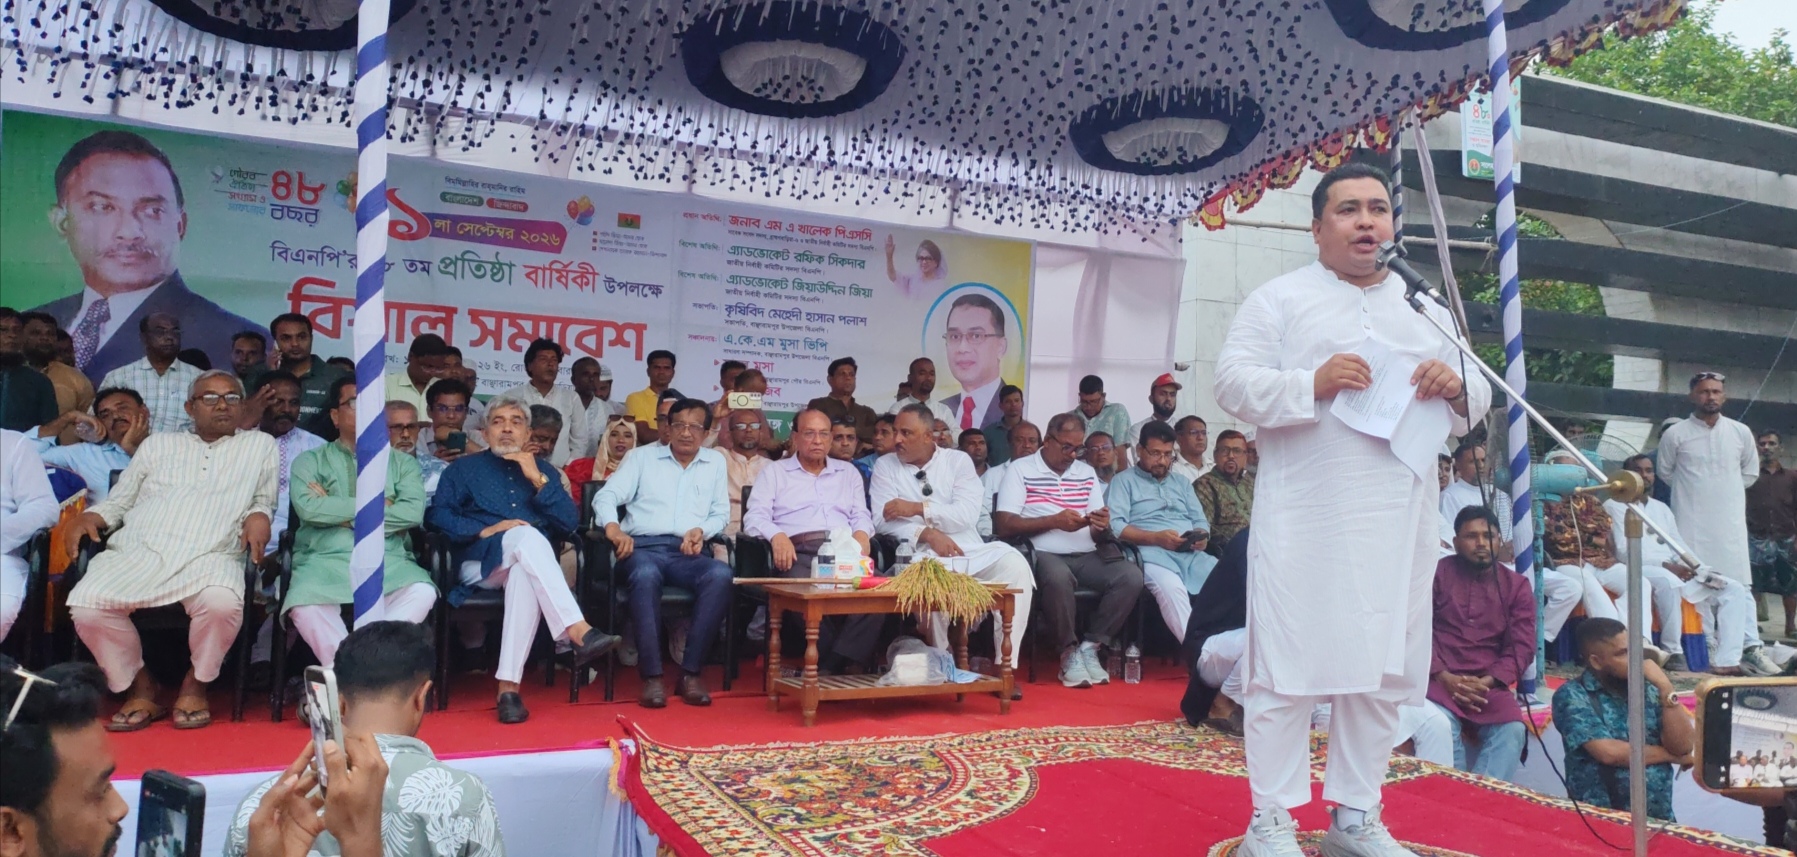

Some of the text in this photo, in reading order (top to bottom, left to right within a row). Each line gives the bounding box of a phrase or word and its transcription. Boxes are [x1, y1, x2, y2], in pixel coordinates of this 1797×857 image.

[271, 170, 326, 205] ৪৮
[270, 203, 320, 227] বছর
[386, 188, 560, 246] ১ লা সেপ্টেম্বর ২০২৬
[728, 215, 872, 241] জনাব এম এ খালেক পিএসসি
[727, 245, 866, 269] এ্যাডভোকেট রফিক সিকদার
[402, 258, 433, 276] তম
[438, 250, 516, 286] প্রতিষ্ঠা
[522, 260, 600, 294] বার্ষিকী
[603, 275, 664, 299] উপলক্ষে
[726, 275, 873, 298] এ্যাডভোকেট জিয়াউদ্দিন জিয়া
[725, 302, 867, 326] কৃষিবিদ মেহেদী হাসান পলাশ
[467, 308, 647, 361] সমাবেশ
[724, 333, 829, 352] এ.কে.এম মুসা ভিপি
